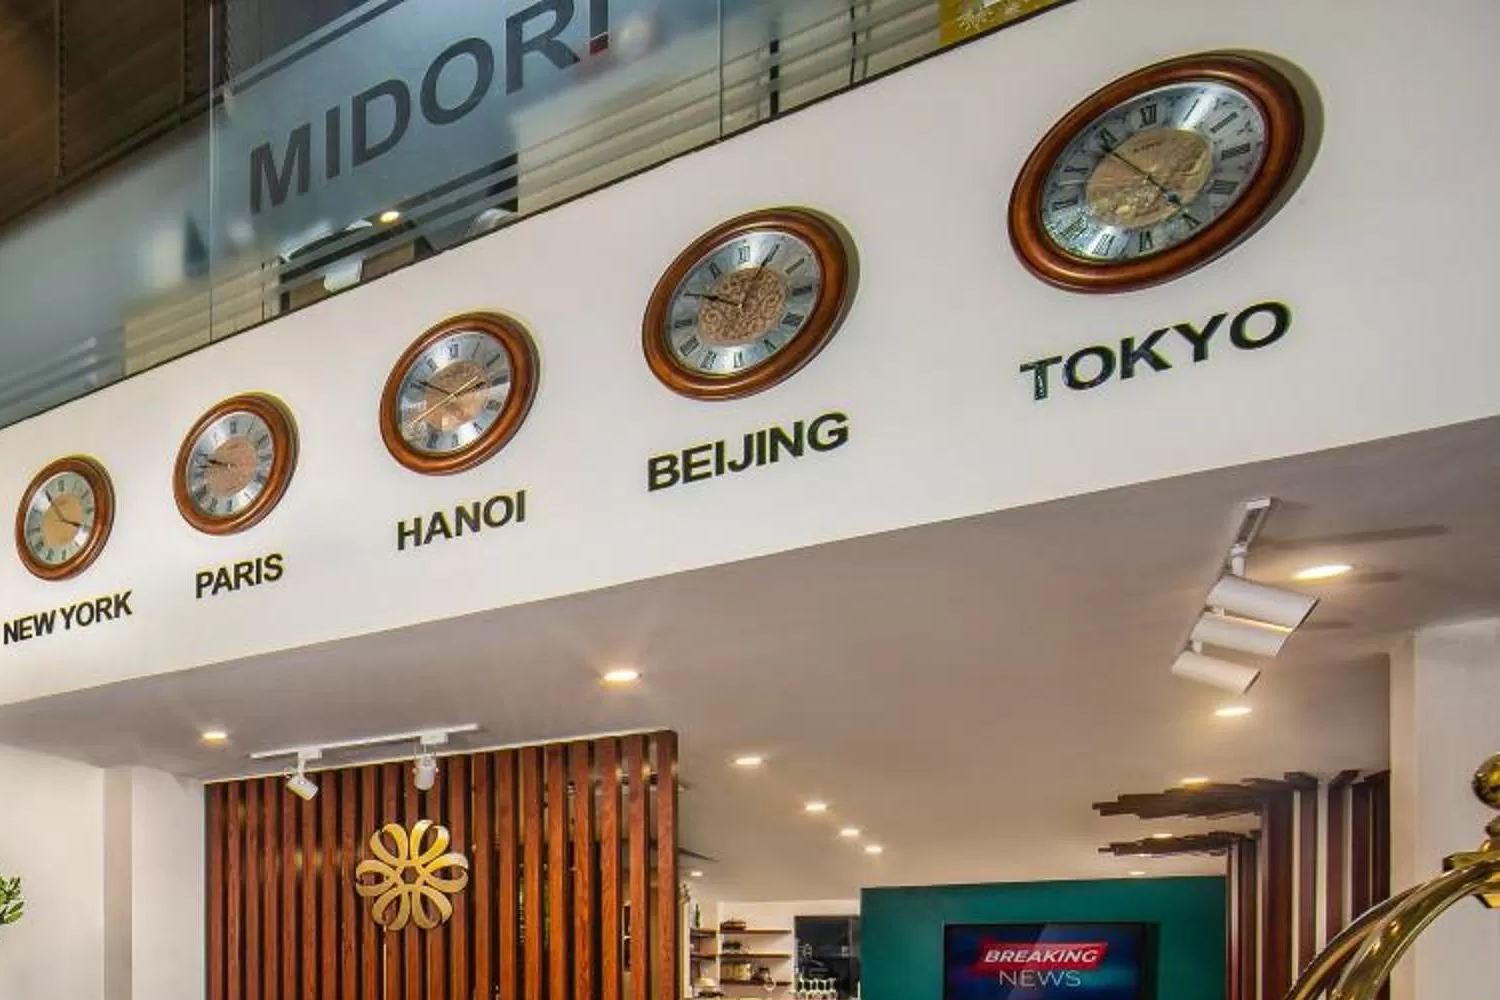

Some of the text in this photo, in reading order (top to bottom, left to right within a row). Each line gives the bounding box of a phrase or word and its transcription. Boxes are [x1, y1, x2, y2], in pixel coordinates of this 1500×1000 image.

[250, 0, 608, 214] MIDORI
[1019, 301, 1291, 401] TOKYO
[648, 412, 849, 492] BEIJING
[398, 490, 526, 550] HANOI
[195, 553, 283, 599] PARIS
[3, 589, 133, 645] NEW YORK
[984, 949, 1099, 963] BREAKING
[1000, 970, 1081, 987] NEWS
